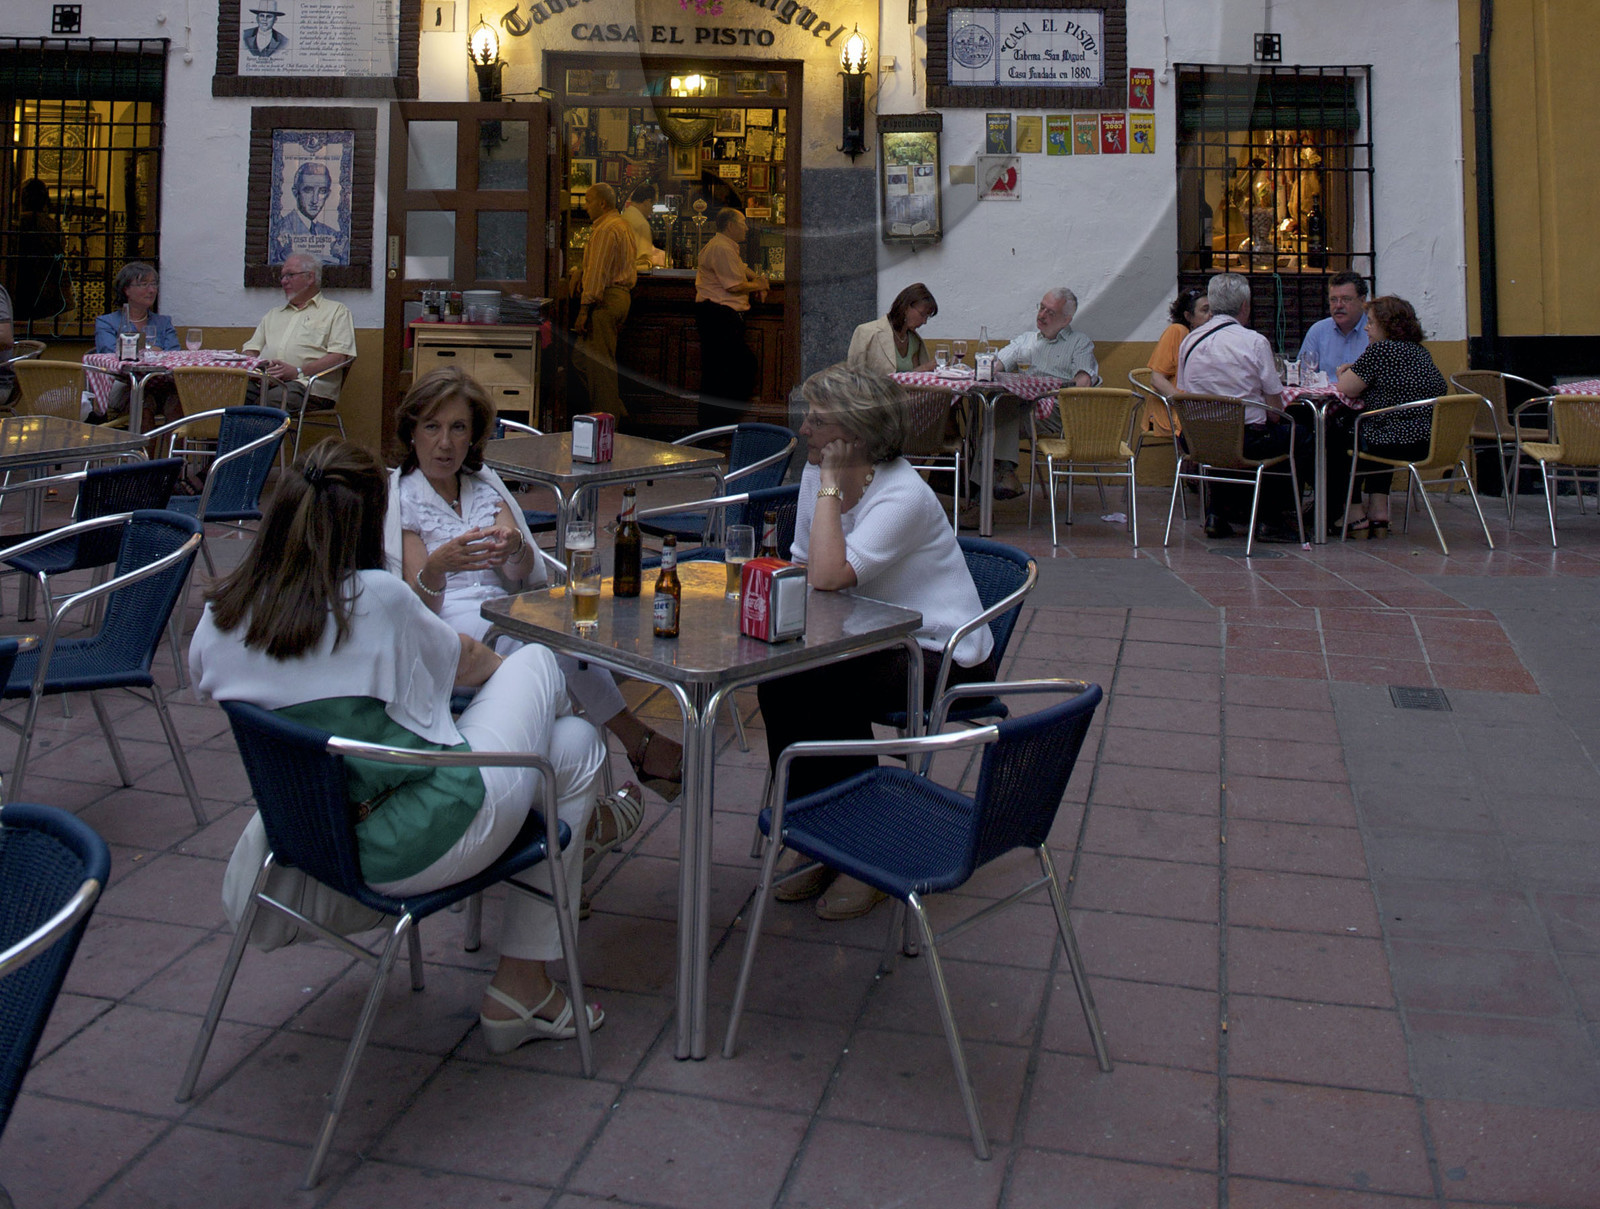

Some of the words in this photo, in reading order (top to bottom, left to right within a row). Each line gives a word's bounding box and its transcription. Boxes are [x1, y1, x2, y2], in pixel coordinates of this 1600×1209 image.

[435, 7, 442, 27] 1
[1042, 18, 1058, 32] EL
[571, 23, 640, 43] CASA
[651, 26, 684, 44] EL
[695, 27, 775, 48] PISTO
[1043, 48, 1060, 62] San
[1061, 49, 1086, 63] Miguel
[1008, 65, 1027, 79] Casa
[1028, 65, 1057, 80] Fundada
[1058, 71, 1068, 79] en
